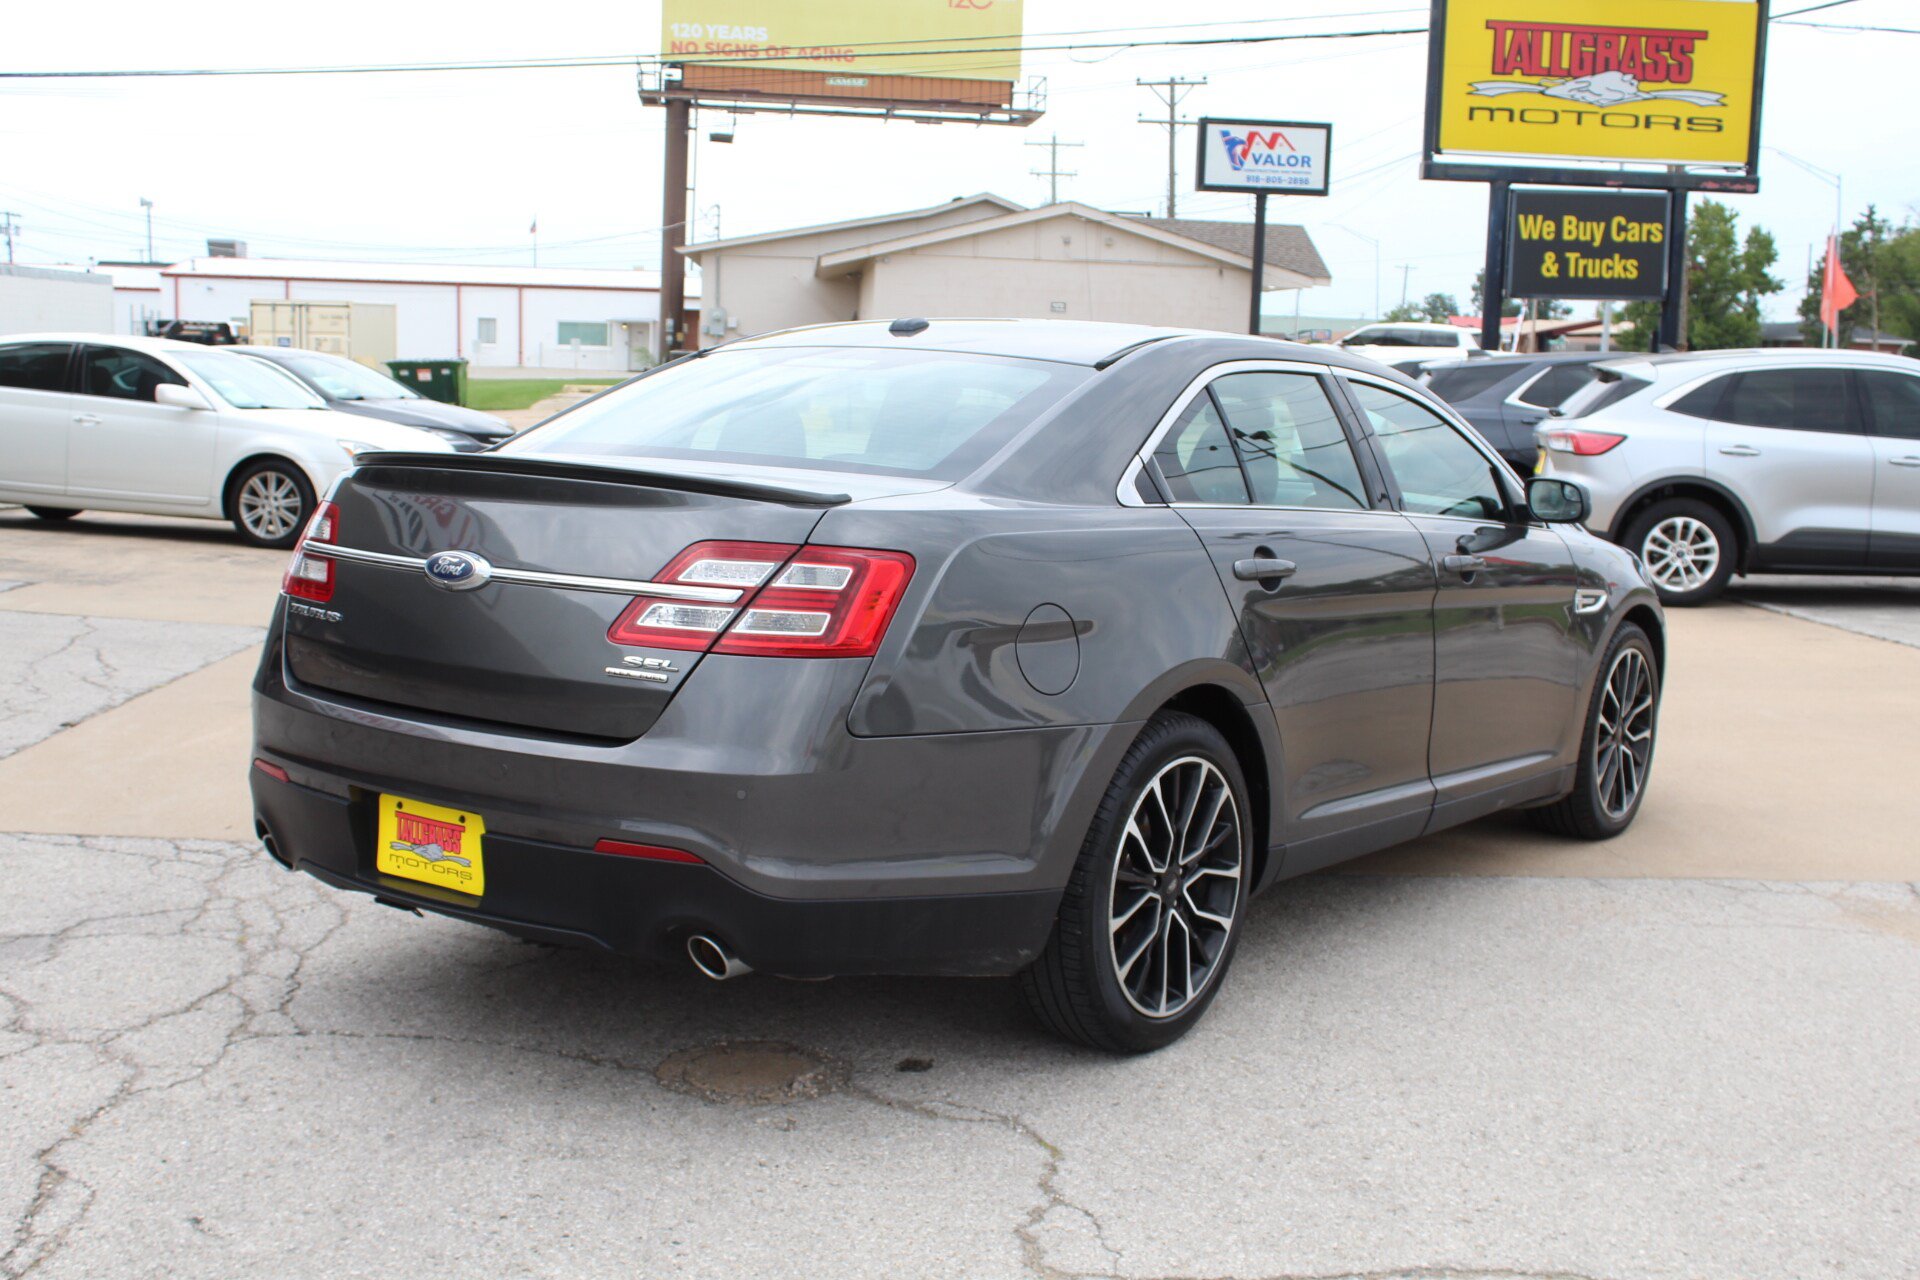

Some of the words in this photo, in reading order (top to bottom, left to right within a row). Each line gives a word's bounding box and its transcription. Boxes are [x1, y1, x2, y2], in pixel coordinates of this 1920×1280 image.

[671, 23, 703, 38] 120
[706, 24, 769, 42] YEARS
[670, 40, 699, 54] NO
[704, 41, 759, 57] SIGNS
[765, 44, 791, 59] OF
[798, 47, 856, 63] AGING
[1486, 20, 1708, 84] TALLGRASS
[1468, 106, 1724, 133] MOTORS
[1251, 152, 1312, 168] VALOR
[1519, 214, 1555, 240] We
[1562, 216, 1606, 247] Buy
[1611, 216, 1663, 243] Cars
[1541, 251, 1558, 278] &
[1566, 252, 1639, 279] Trucks
[434, 556, 466, 576] Ford
[622, 655, 679, 672] SEL
[389, 853, 472, 881] MOTORS
